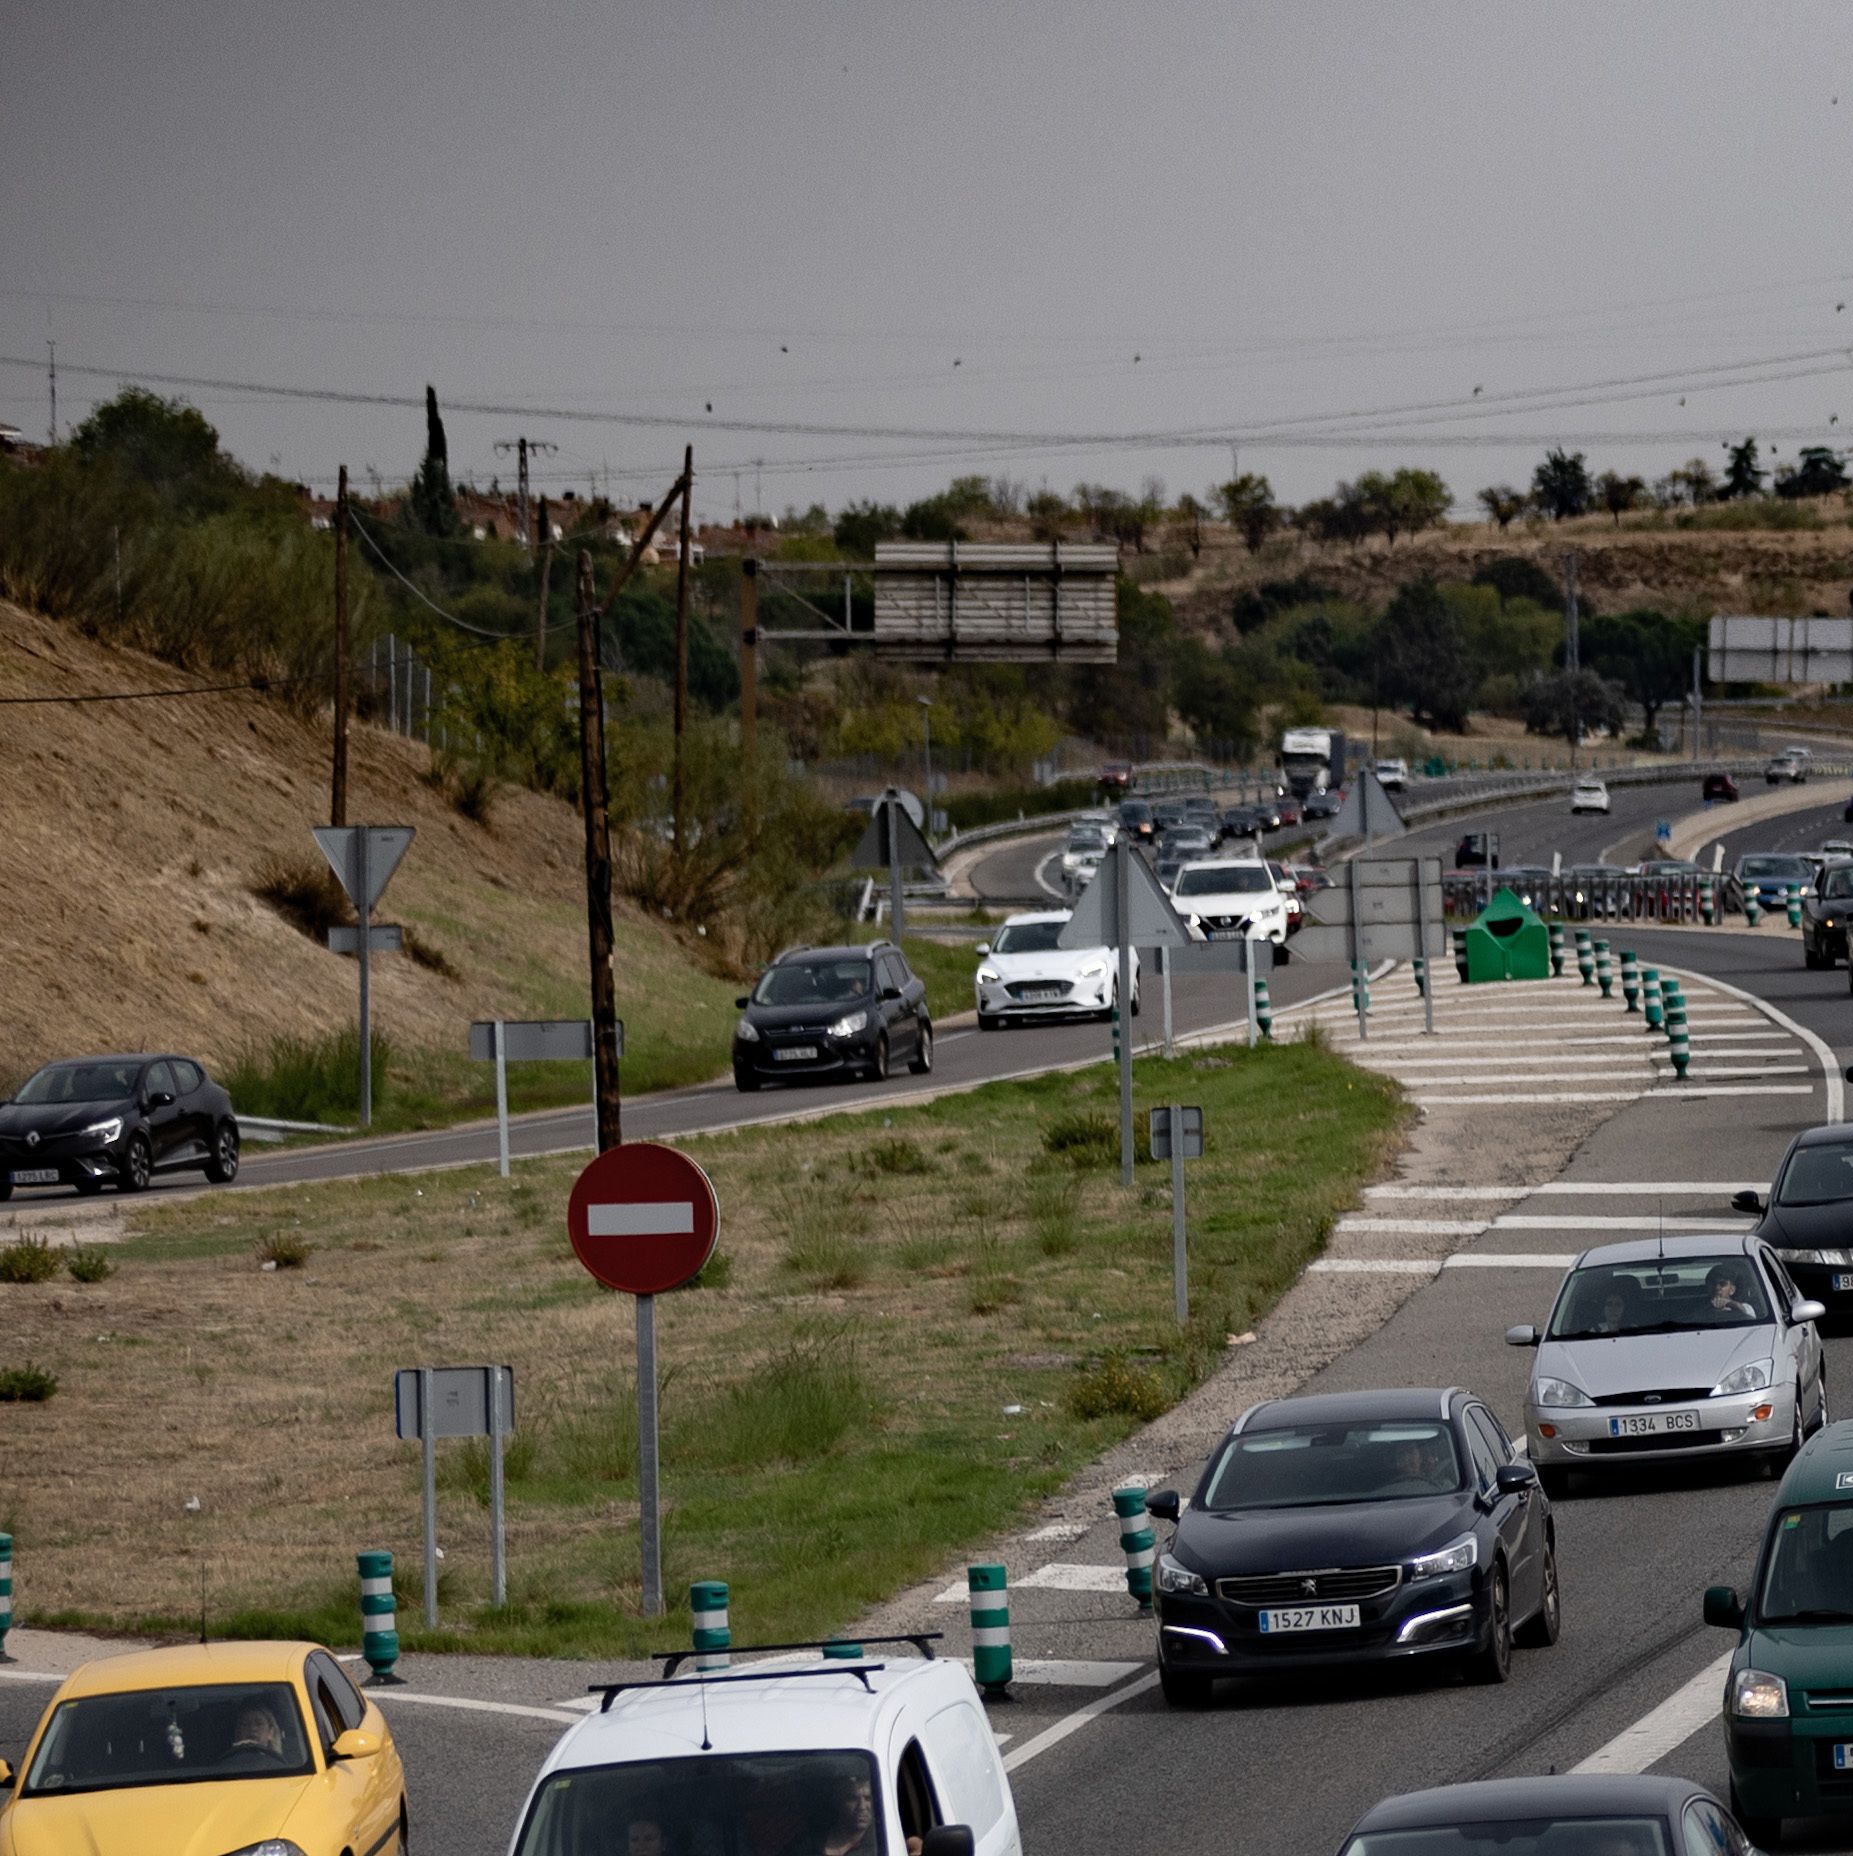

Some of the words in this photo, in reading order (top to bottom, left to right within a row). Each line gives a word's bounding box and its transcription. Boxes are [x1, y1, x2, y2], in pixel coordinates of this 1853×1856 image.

[1622, 1417, 1656, 1433] 1334
[1666, 1414, 1694, 1430] BCS
[1273, 1610, 1315, 1629] 1527
[1321, 1608, 1355, 1626] KNJ
